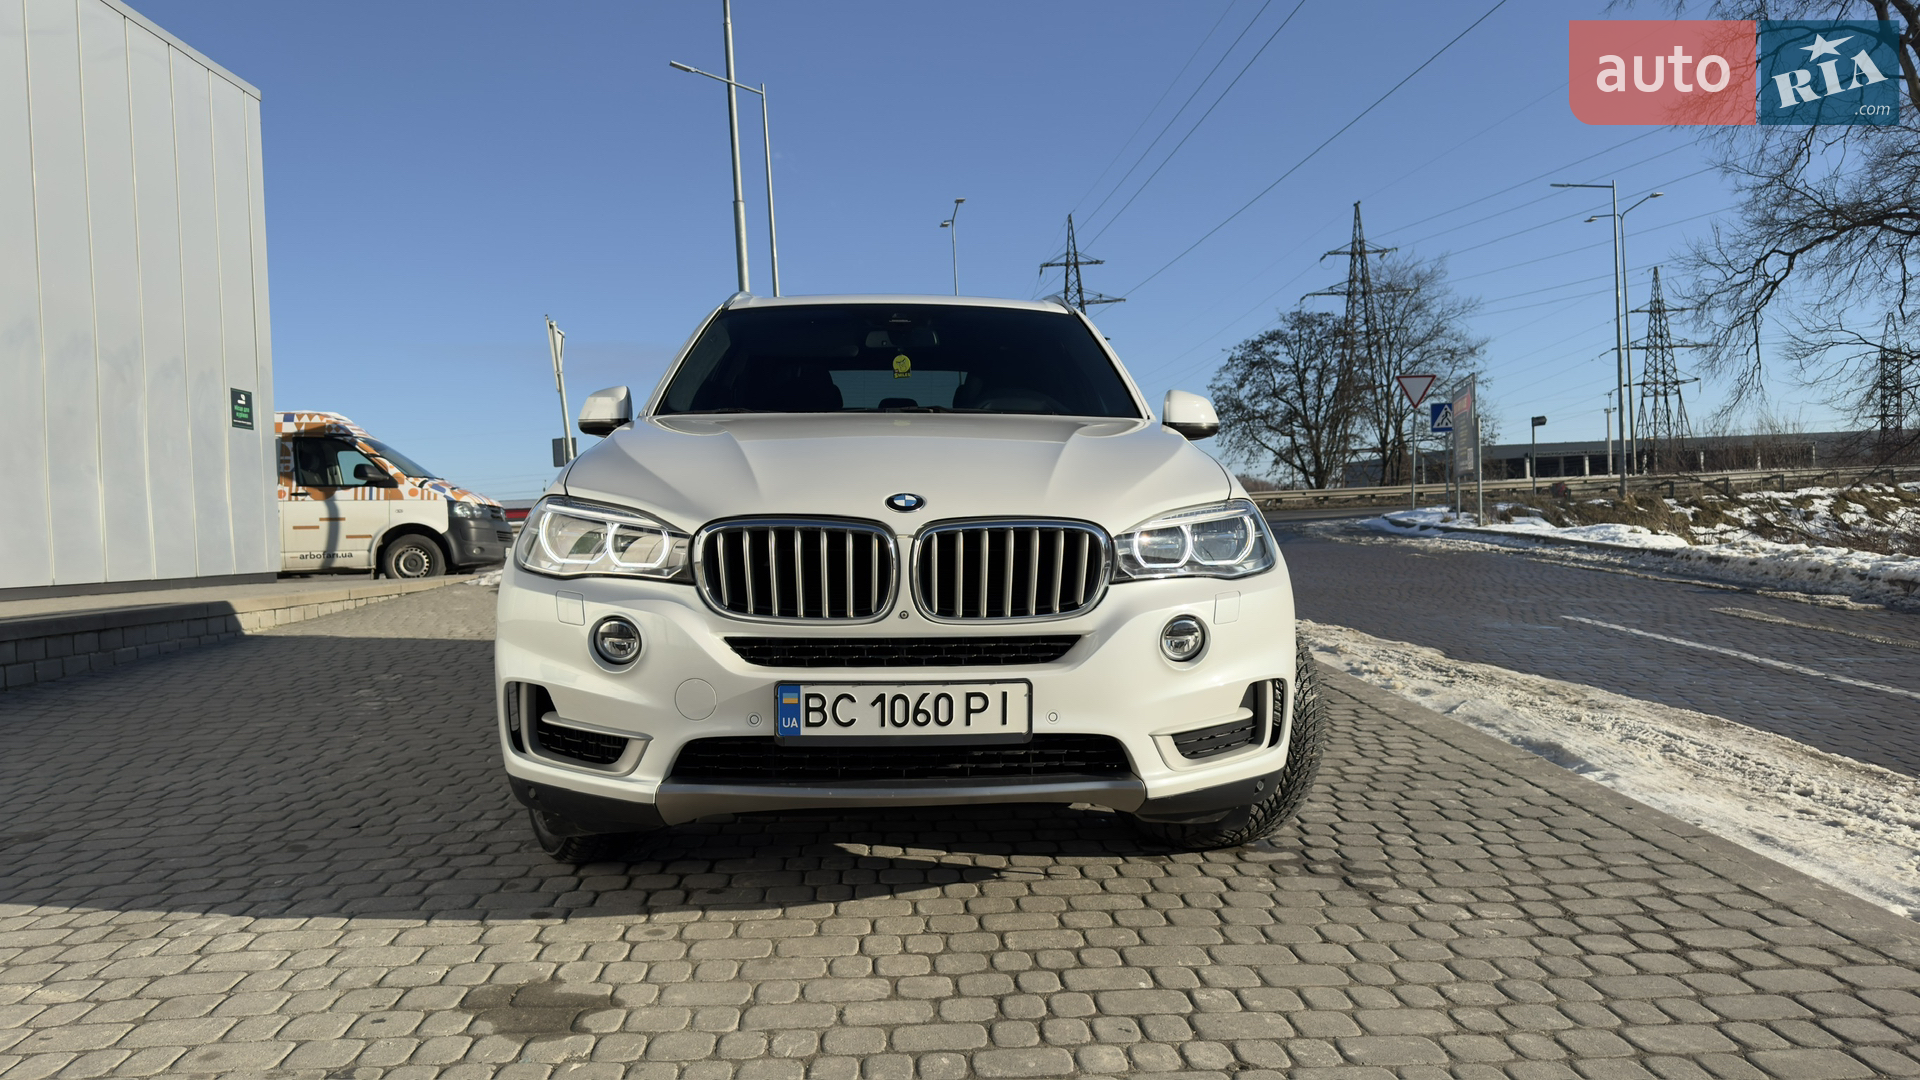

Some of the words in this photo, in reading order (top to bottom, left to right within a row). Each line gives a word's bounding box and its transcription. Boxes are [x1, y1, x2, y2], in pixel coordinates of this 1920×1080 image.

[804, 693, 857, 727] BC
[870, 692, 954, 727] 1060
[782, 717, 798, 728] UA
